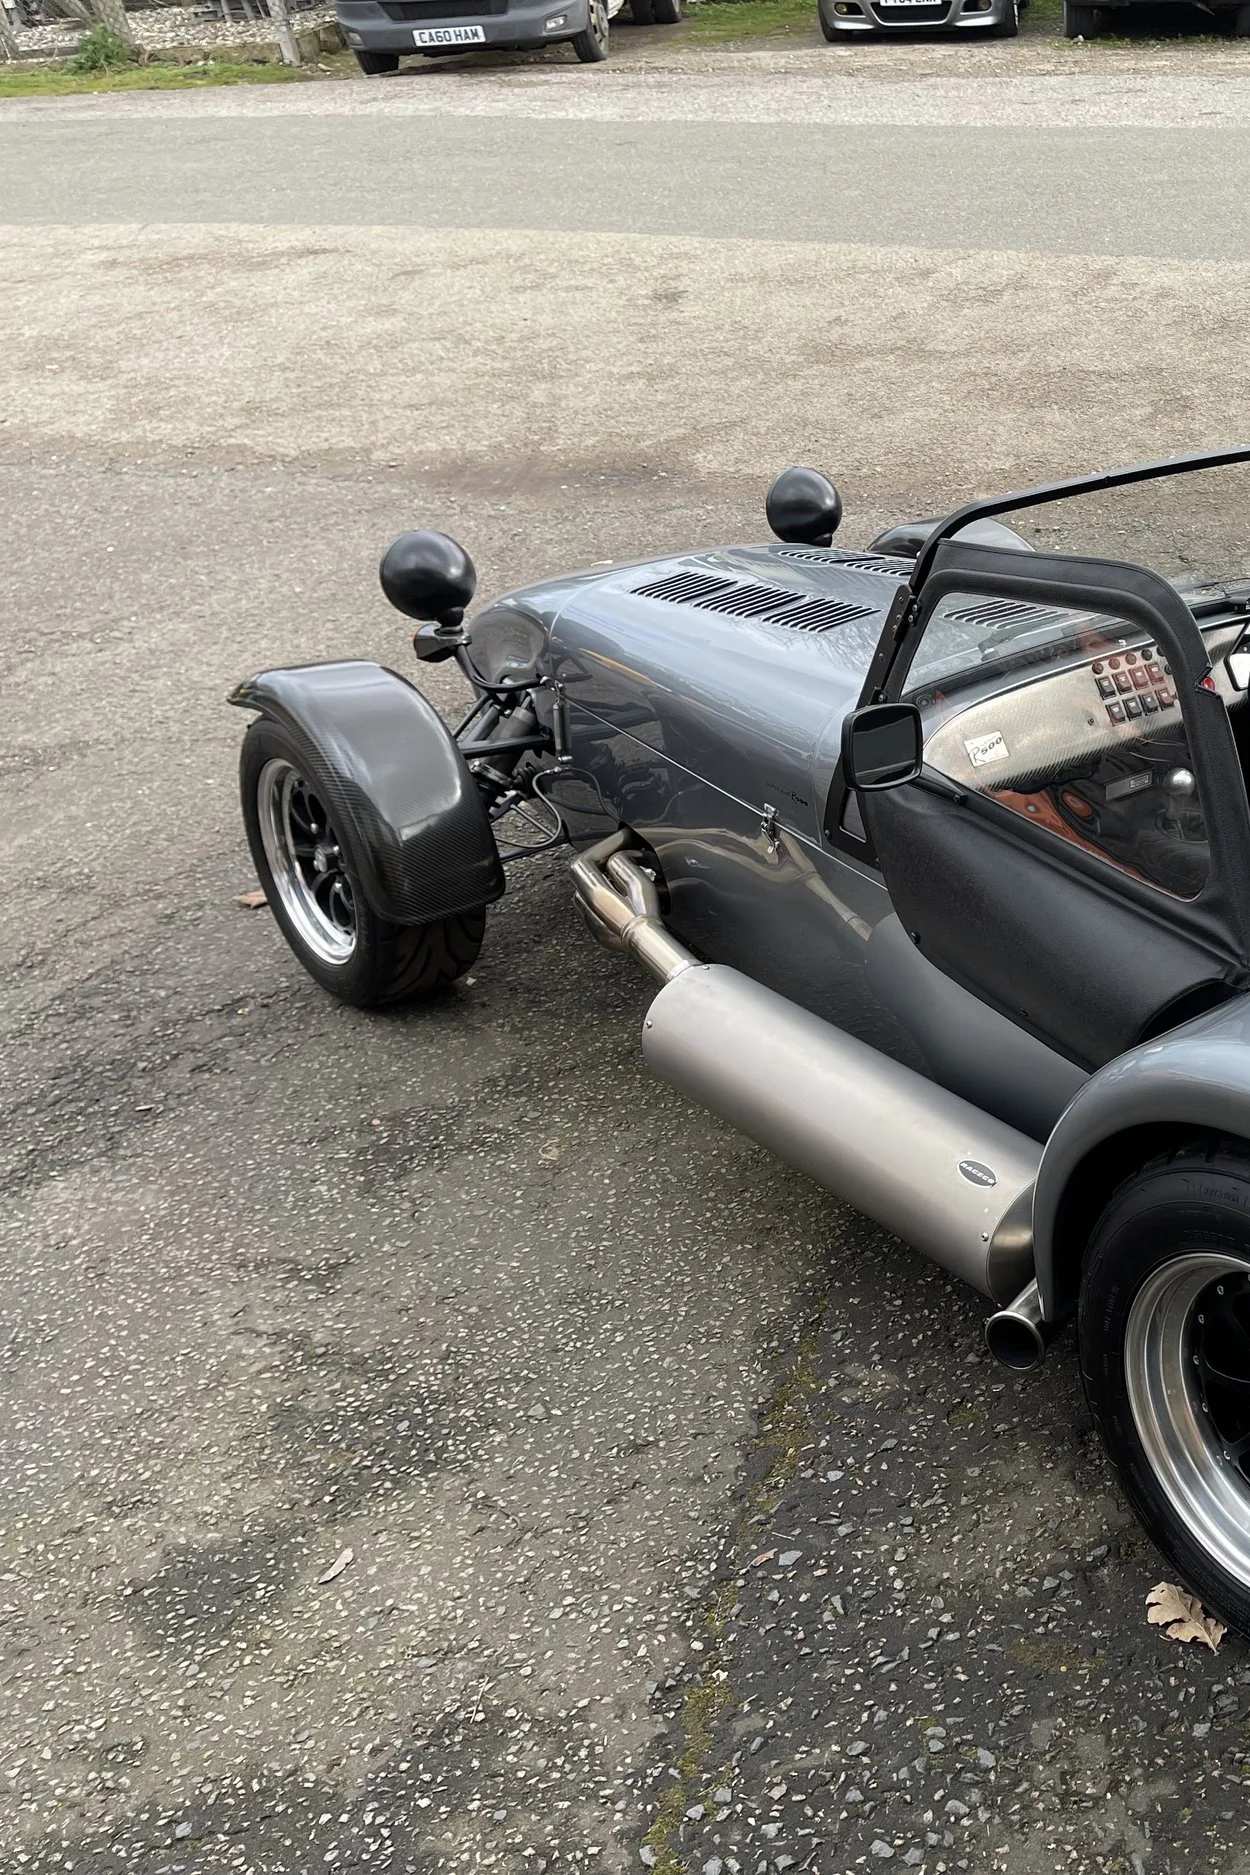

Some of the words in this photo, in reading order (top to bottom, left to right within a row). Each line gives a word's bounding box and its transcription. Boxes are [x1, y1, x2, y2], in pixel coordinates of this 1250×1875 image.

[419, 30, 452, 44] CA60
[453, 28, 480, 42] HAM
[959, 1162, 995, 1184] RACECO
